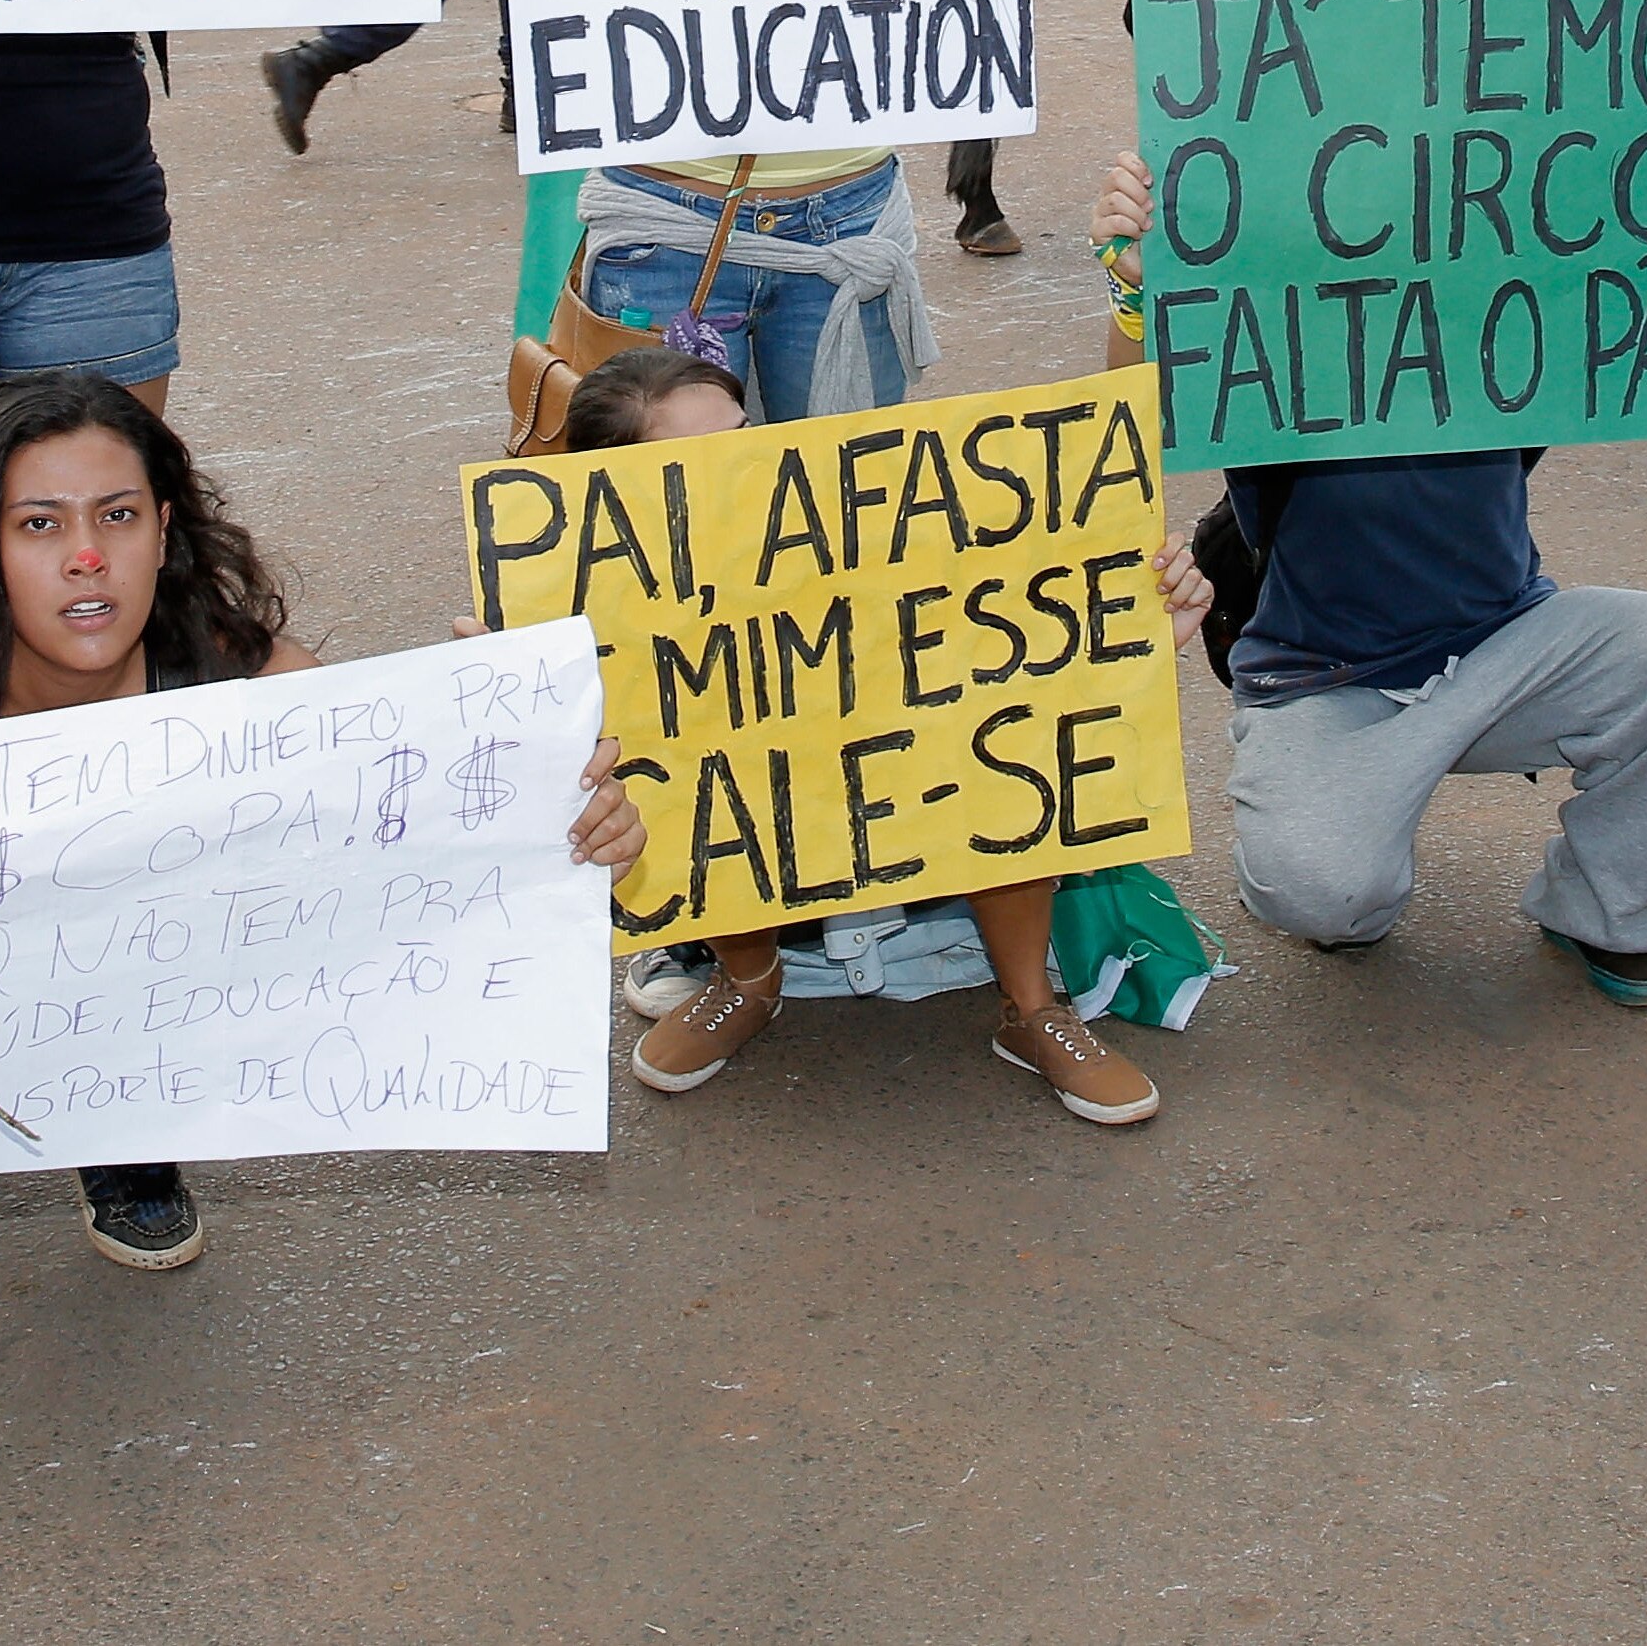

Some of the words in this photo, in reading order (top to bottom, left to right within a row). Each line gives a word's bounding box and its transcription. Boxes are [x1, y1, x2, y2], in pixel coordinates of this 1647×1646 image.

[1162, 136, 1242, 267] O
[1154, 277, 1452, 450] FALTA
[1480, 279, 1544, 414] O
[472, 460, 716, 631] PAI,
[754, 401, 1154, 587] AFASTA
[653, 595, 856, 739] MIM
[897, 549, 1155, 709] ESSE
[150, 697, 405, 787] DINHEIRO
[450, 657, 564, 728] PRA
[51, 892, 192, 979] NÃO
[211, 884, 343, 954] TEM
[379, 865, 511, 931] PRA
[143, 941, 449, 1033] EDUCAÇÃO
[482, 956, 535, 1000] E
[231, 1055, 297, 1105] DE
